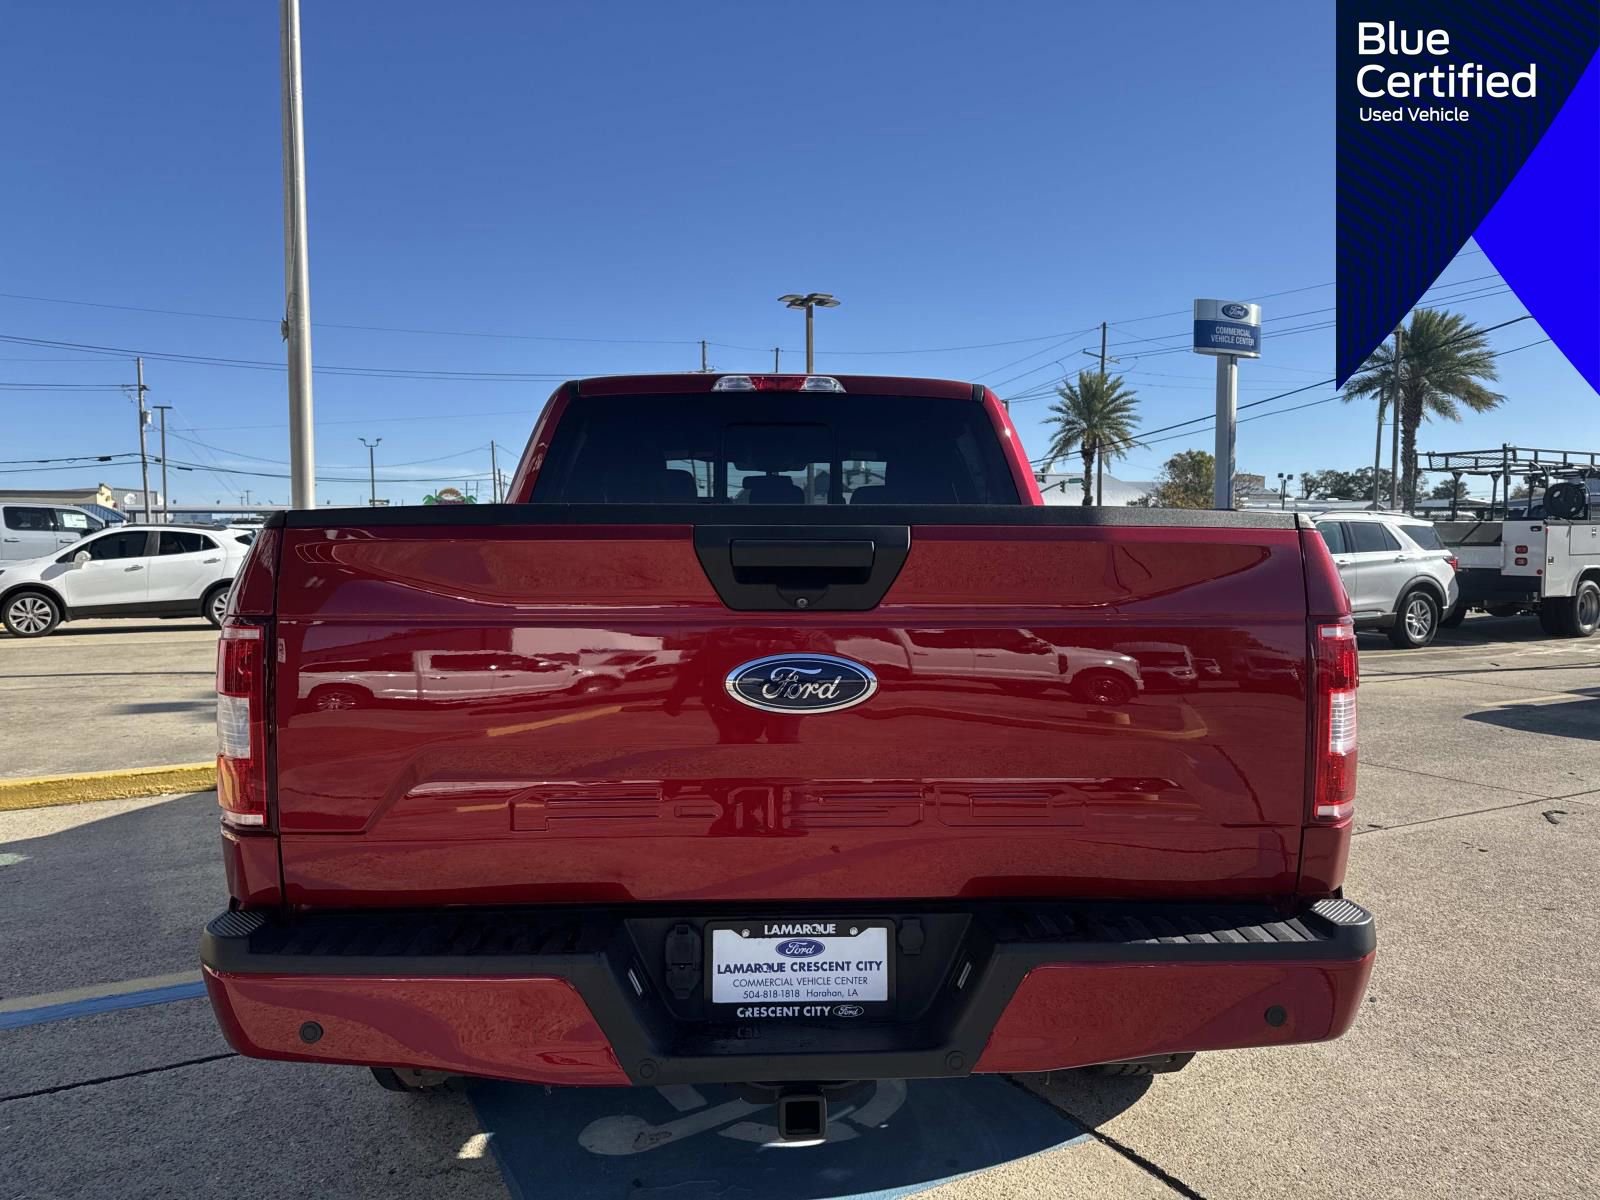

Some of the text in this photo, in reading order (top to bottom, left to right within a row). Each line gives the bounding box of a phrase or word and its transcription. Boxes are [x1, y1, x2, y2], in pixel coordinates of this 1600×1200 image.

[1215, 326, 1251, 337] COMMERCIAL
[1210, 334, 1254, 346] VEHICLE CENTER
[762, 666, 843, 699] Ford
[764, 923, 836, 935] LAMARQUE
[785, 942, 814, 955] Ford
[717, 960, 883, 975] LAMARQUE CRESCENT CITY
[732, 976, 868, 988] COMMERCIAL VEHICLE CENTER
[743, 989, 859, 999] 504-818-1818 Harahan, LA
[736, 1006, 859, 1018] CRESCENT CITY Ford
